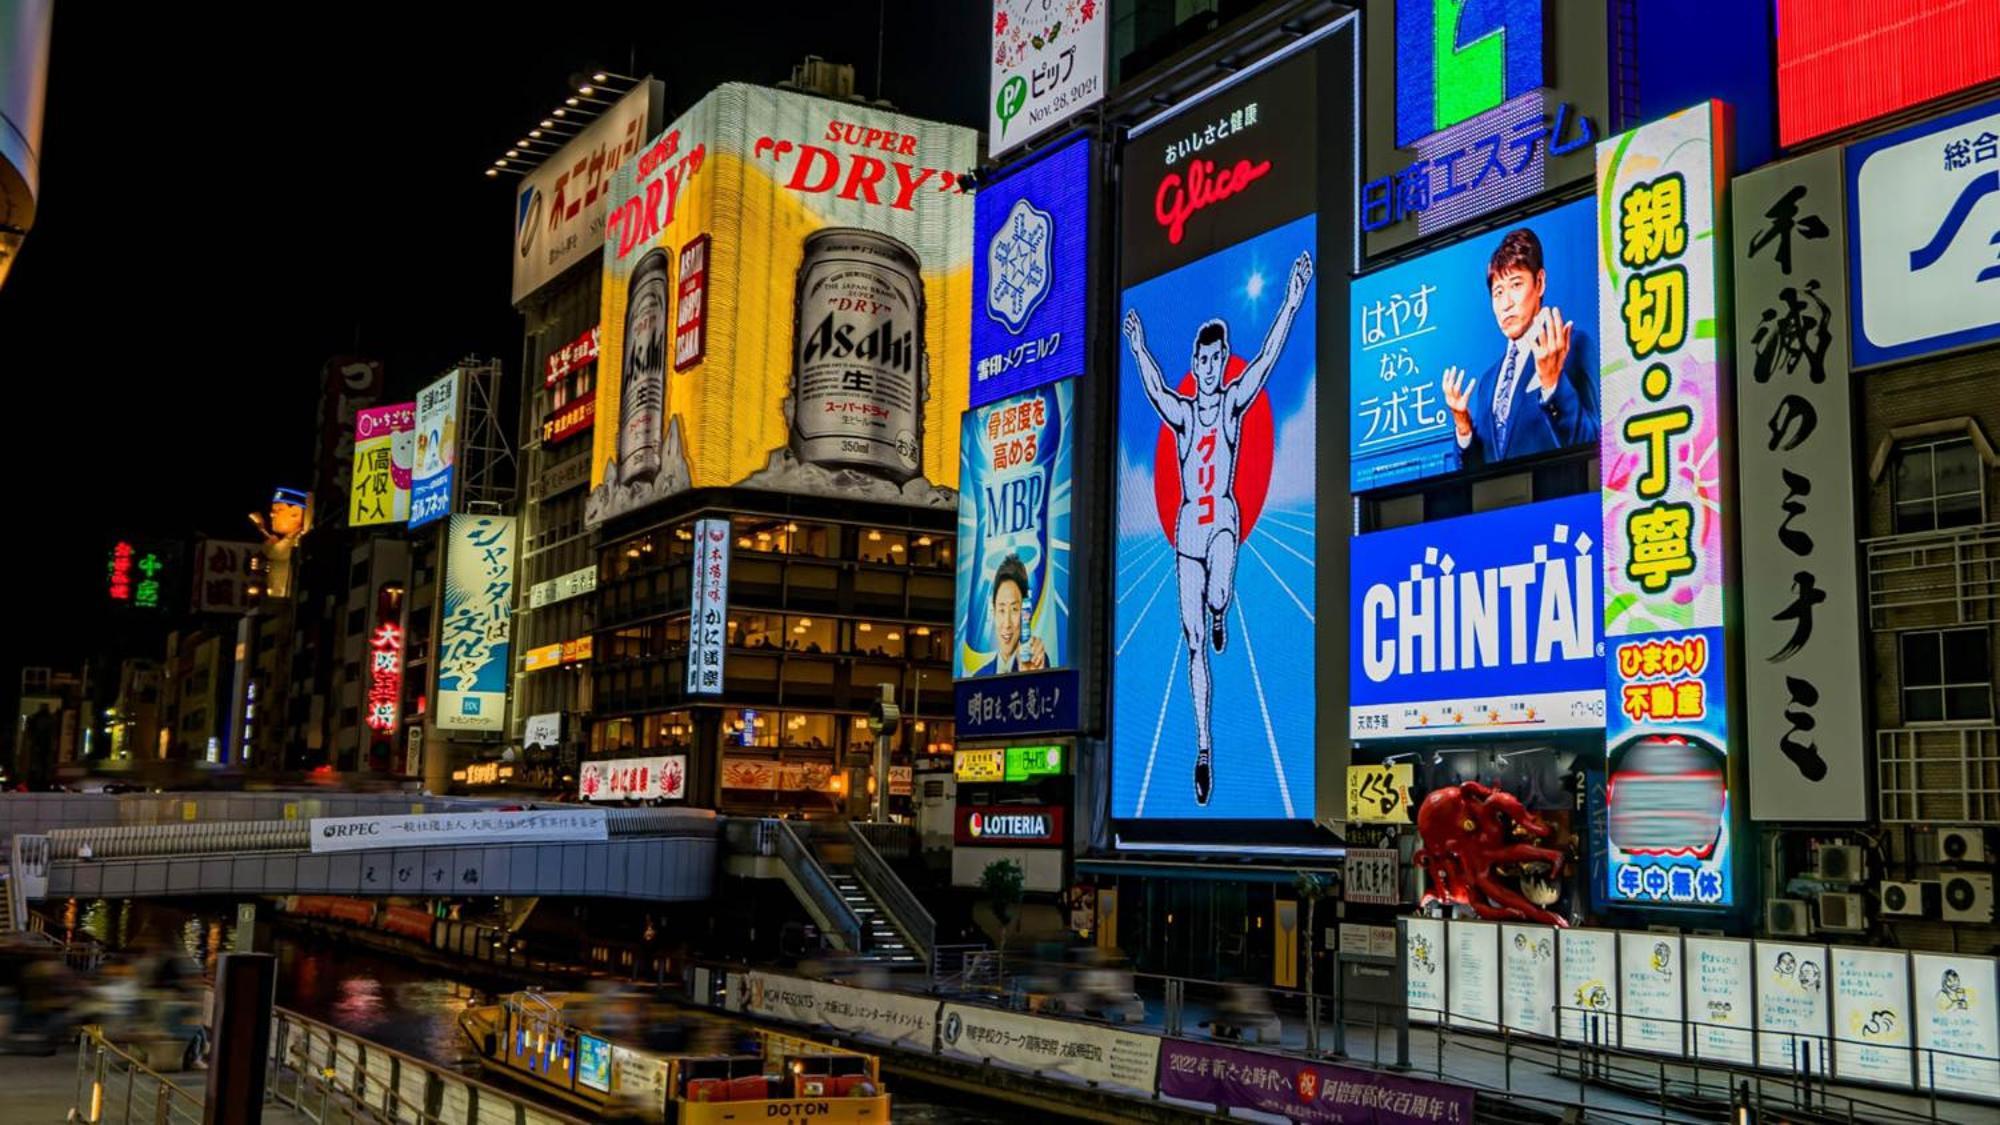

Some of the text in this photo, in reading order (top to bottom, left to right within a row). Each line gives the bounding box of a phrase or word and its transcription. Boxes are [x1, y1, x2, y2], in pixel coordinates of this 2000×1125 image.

[1032, 44, 1077, 98] ピップ
[635, 129, 680, 184] SUPER
[825, 119, 918, 157] SUPER
[1165, 103, 1258, 164] おいしさと健康
[1944, 131, 1999, 171] 総合
[1362, 102, 1594, 232] 日商エステム
[1362, 285, 1437, 345] はやす
[803, 311, 912, 374] Asahi
[976, 332, 1060, 382] 雪印メグミルク
[1379, 350, 1420, 381] なら、
[842, 370, 873, 393] 生
[1621, 171, 1697, 594] 親切・丁寧
[825, 402, 889, 419] スーパードライ
[988, 400, 1044, 438] 骨密度を
[1358, 382, 1447, 440] ラボモ。
[841, 440, 870, 454] 350ml
[993, 435, 1037, 470] 高める
[355, 451, 374, 522] バイト
[369, 447, 391, 519] 高収入
[1197, 428, 1217, 525] グリコ
[1747, 185, 1832, 783] 不滅のミナミ
[985, 475, 1041, 538] MBP
[1362, 523, 1595, 682] CHINTAI
[703, 608, 721, 688] かに道楽
[1619, 639, 1705, 676] ひまわり
[1623, 684, 1703, 719] 不動産
[983, 815, 1045, 835] LOTTERIA
[364, 868, 480, 884] えびす橋
[1618, 868, 1721, 900] 年中無休
[1299, 1071, 1316, 1096] 祝
[768, 1103, 829, 1117] DOTON
